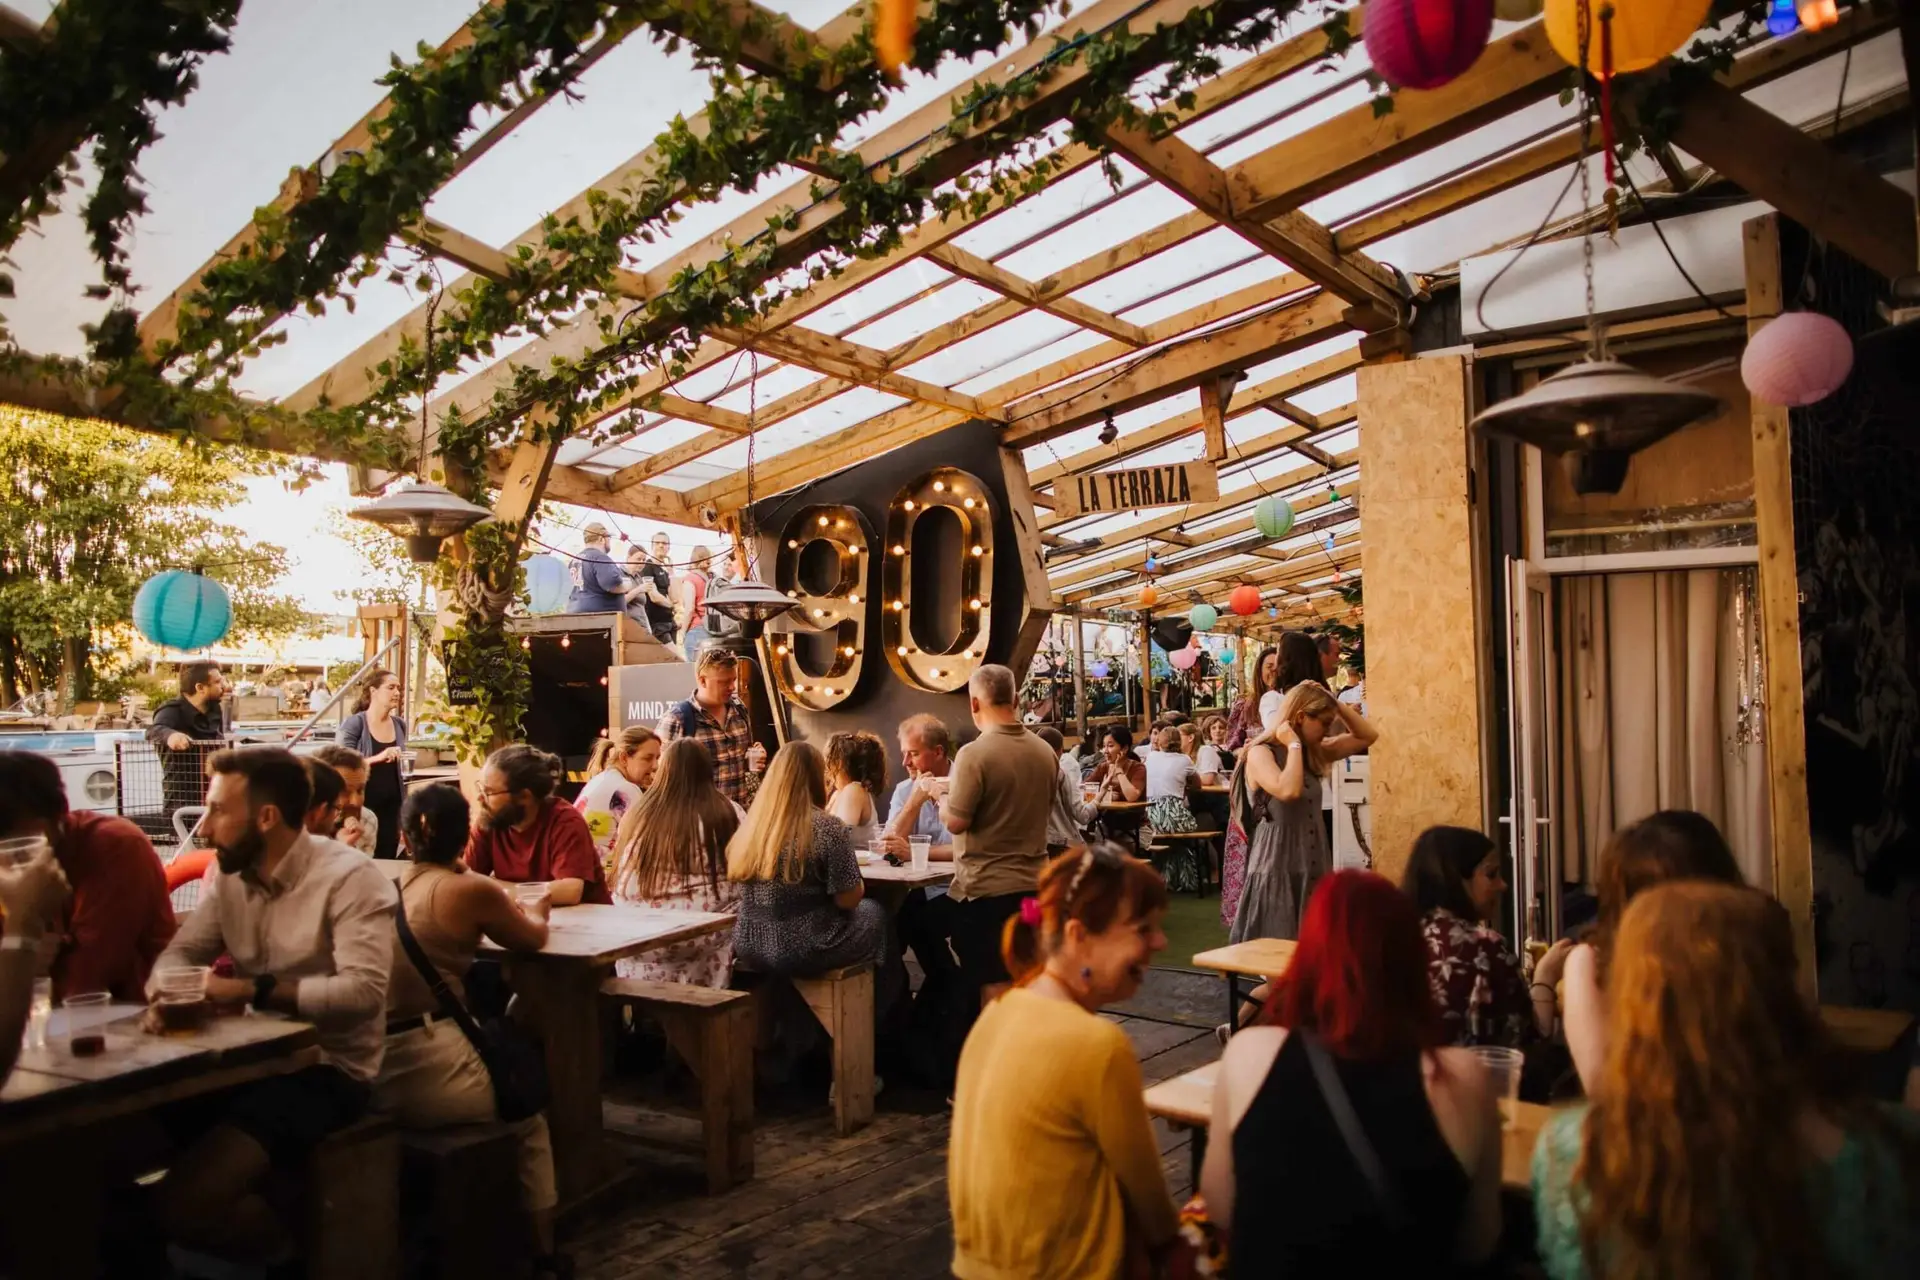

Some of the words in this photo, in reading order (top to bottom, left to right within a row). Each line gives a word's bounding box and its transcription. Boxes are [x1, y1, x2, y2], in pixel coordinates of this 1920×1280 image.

[1078, 476, 1101, 513] LA
[1106, 465, 1191, 509] TERRAZA
[770, 466, 994, 711] 90
[628, 701, 664, 720] MIND
